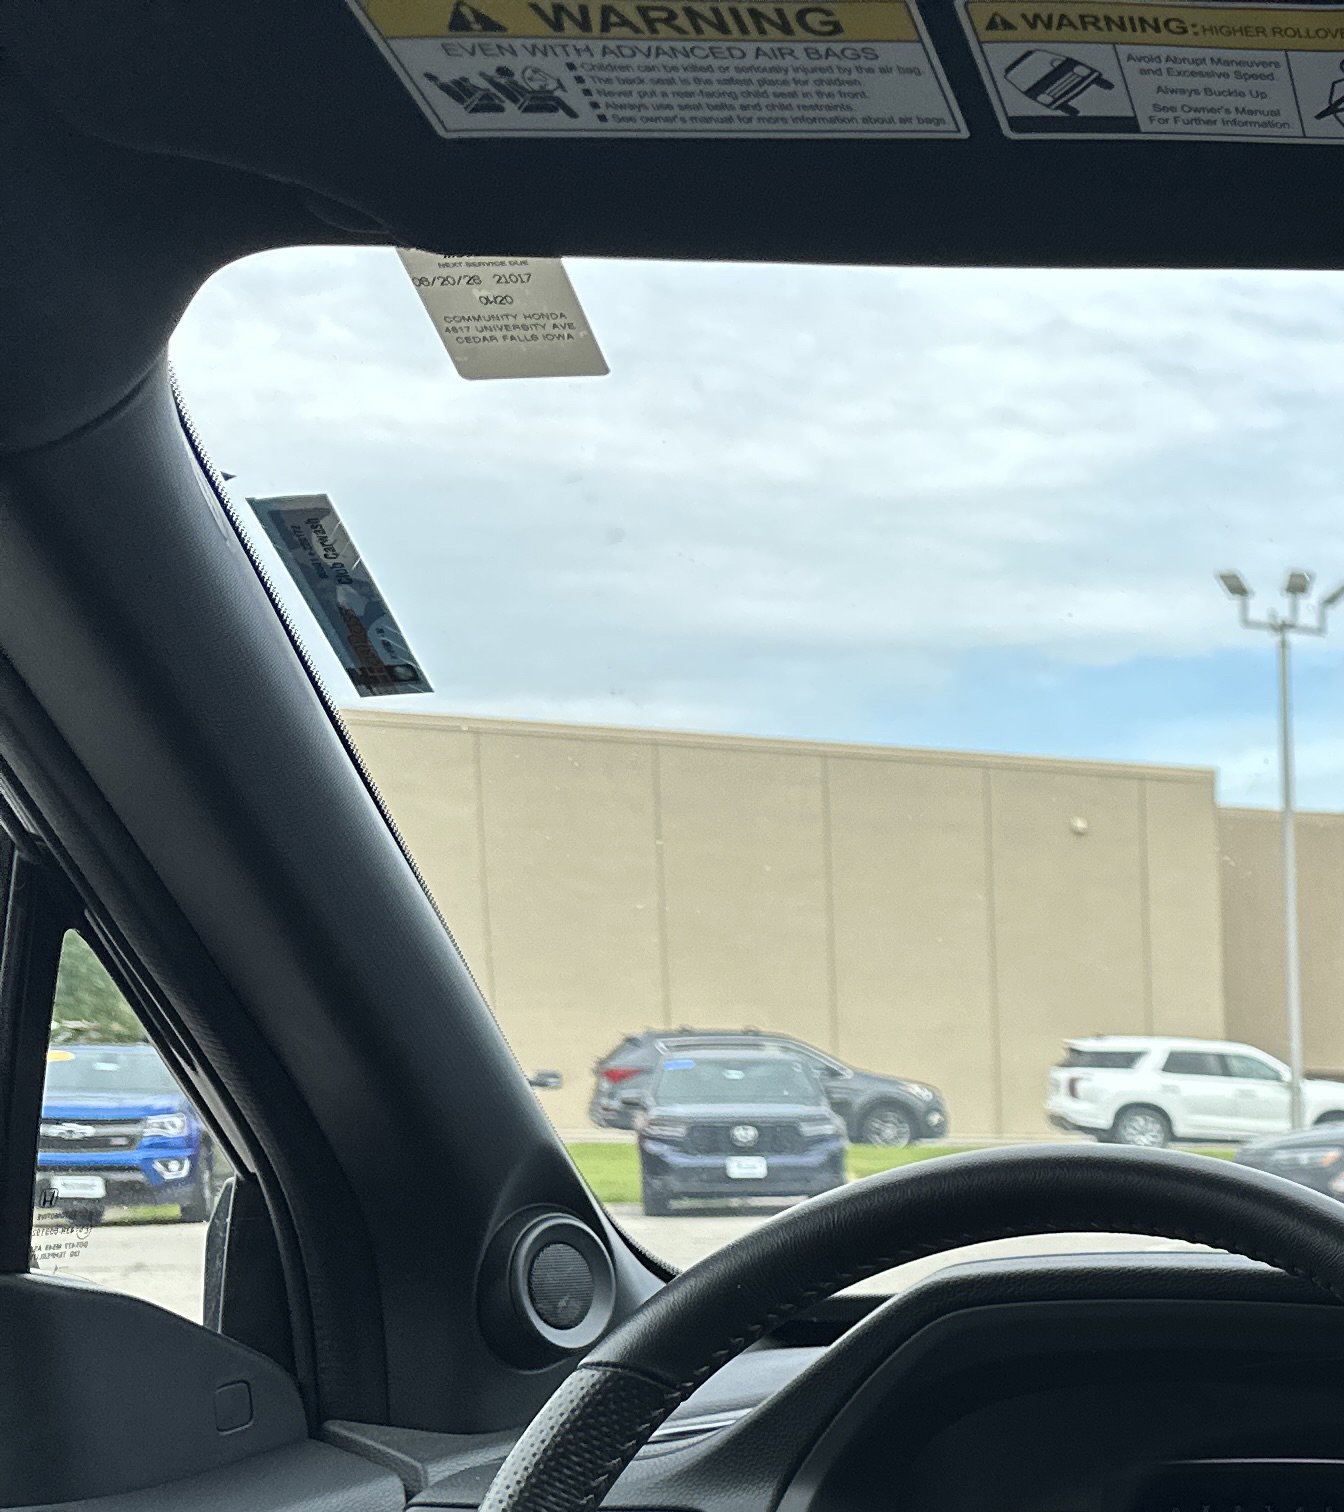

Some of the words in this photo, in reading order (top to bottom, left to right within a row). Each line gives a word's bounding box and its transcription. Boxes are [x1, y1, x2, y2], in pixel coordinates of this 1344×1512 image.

[528, 2, 843, 37] WARNING
[1020, 12, 1199, 37] WARNING:
[1201, 25, 1273, 39] HIGHER
[440, 43, 518, 57] EVEN
[522, 44, 596, 58] WITH
[600, 45, 746, 60] ADVANCED
[754, 46, 797, 60] AIR
[804, 47, 880, 61] BAGS
[1126, 53, 1162, 64] Avoid
[1165, 55, 1207, 67] Abrupt
[1210, 57, 1282, 69] Maneuvers
[580, 62, 634, 73] Children
[637, 64, 660, 73] can
[662, 63, 679, 73] be
[681, 63, 714, 73] killed
[836, 64, 852, 76] by
[855, 64, 875, 74] the
[878, 66, 894, 75] air
[1138, 67, 1163, 76] and
[1166, 67, 1231, 79] Excessive
[693, 76, 714, 85] the
[792, 78, 811, 87] for
[740, 90, 769, 99] child
[815, 90, 835, 99] the
[1156, 85, 1202, 98] Always
[1203, 87, 1246, 98] Buckle
[604, 102, 649, 113] Always
[739, 102, 762, 111] and
[1152, 103, 1178, 113] See
[1181, 104, 1233, 115] Owner's
[1235, 106, 1281, 117] Manual
[612, 114, 637, 123] See
[861, 115, 896, 125] about
[1148, 115, 1170, 125] For
[1173, 116, 1218, 127] Further
[492, 273, 532, 285] 21017
[478, 294, 514, 306] 0W20
[443, 313, 518, 324] COMMUNITY
[522, 311, 568, 321] HONDA
[474, 323, 546, 333] UNIVERSITY
[551, 322, 577, 331] AVE
[455, 335, 499, 345] CEDAR
[502, 333, 539, 343] FALLS
[543, 332, 575, 341] IOWA
[305, 517, 339, 561] Carwash
[329, 561, 353, 586] Club
